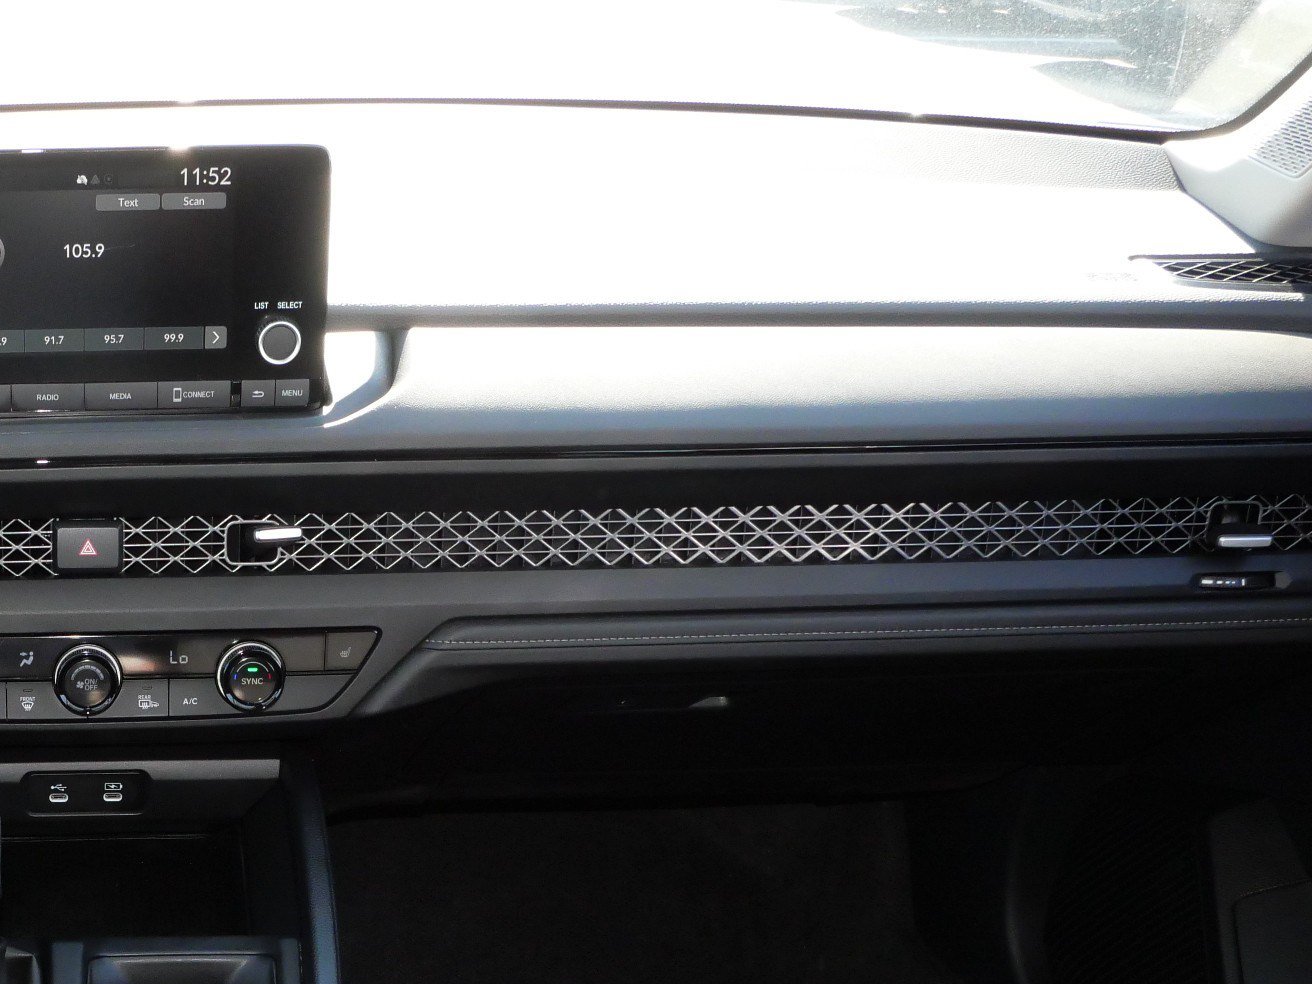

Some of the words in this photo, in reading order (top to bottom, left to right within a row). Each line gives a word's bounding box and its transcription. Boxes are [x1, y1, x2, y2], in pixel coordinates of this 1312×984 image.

[180, 167, 232, 185] 11:52
[118, 197, 138, 207] Text
[183, 196, 205, 206] Scan
[63, 243, 105, 258] 105.9
[254, 302, 269, 310] LIST
[277, 301, 303, 310] SELECT
[44, 335, 65, 346] 91.7
[104, 334, 124, 344] 95.7
[164, 332, 184, 343] 99.9
[36, 393, 59, 402] RADIO
[109, 392, 132, 401] MEDIA
[182, 390, 215, 399] CONNECT
[281, 389, 303, 398] MENU
[241, 677, 264, 685] SYNC
[182, 697, 198, 705] A/C
